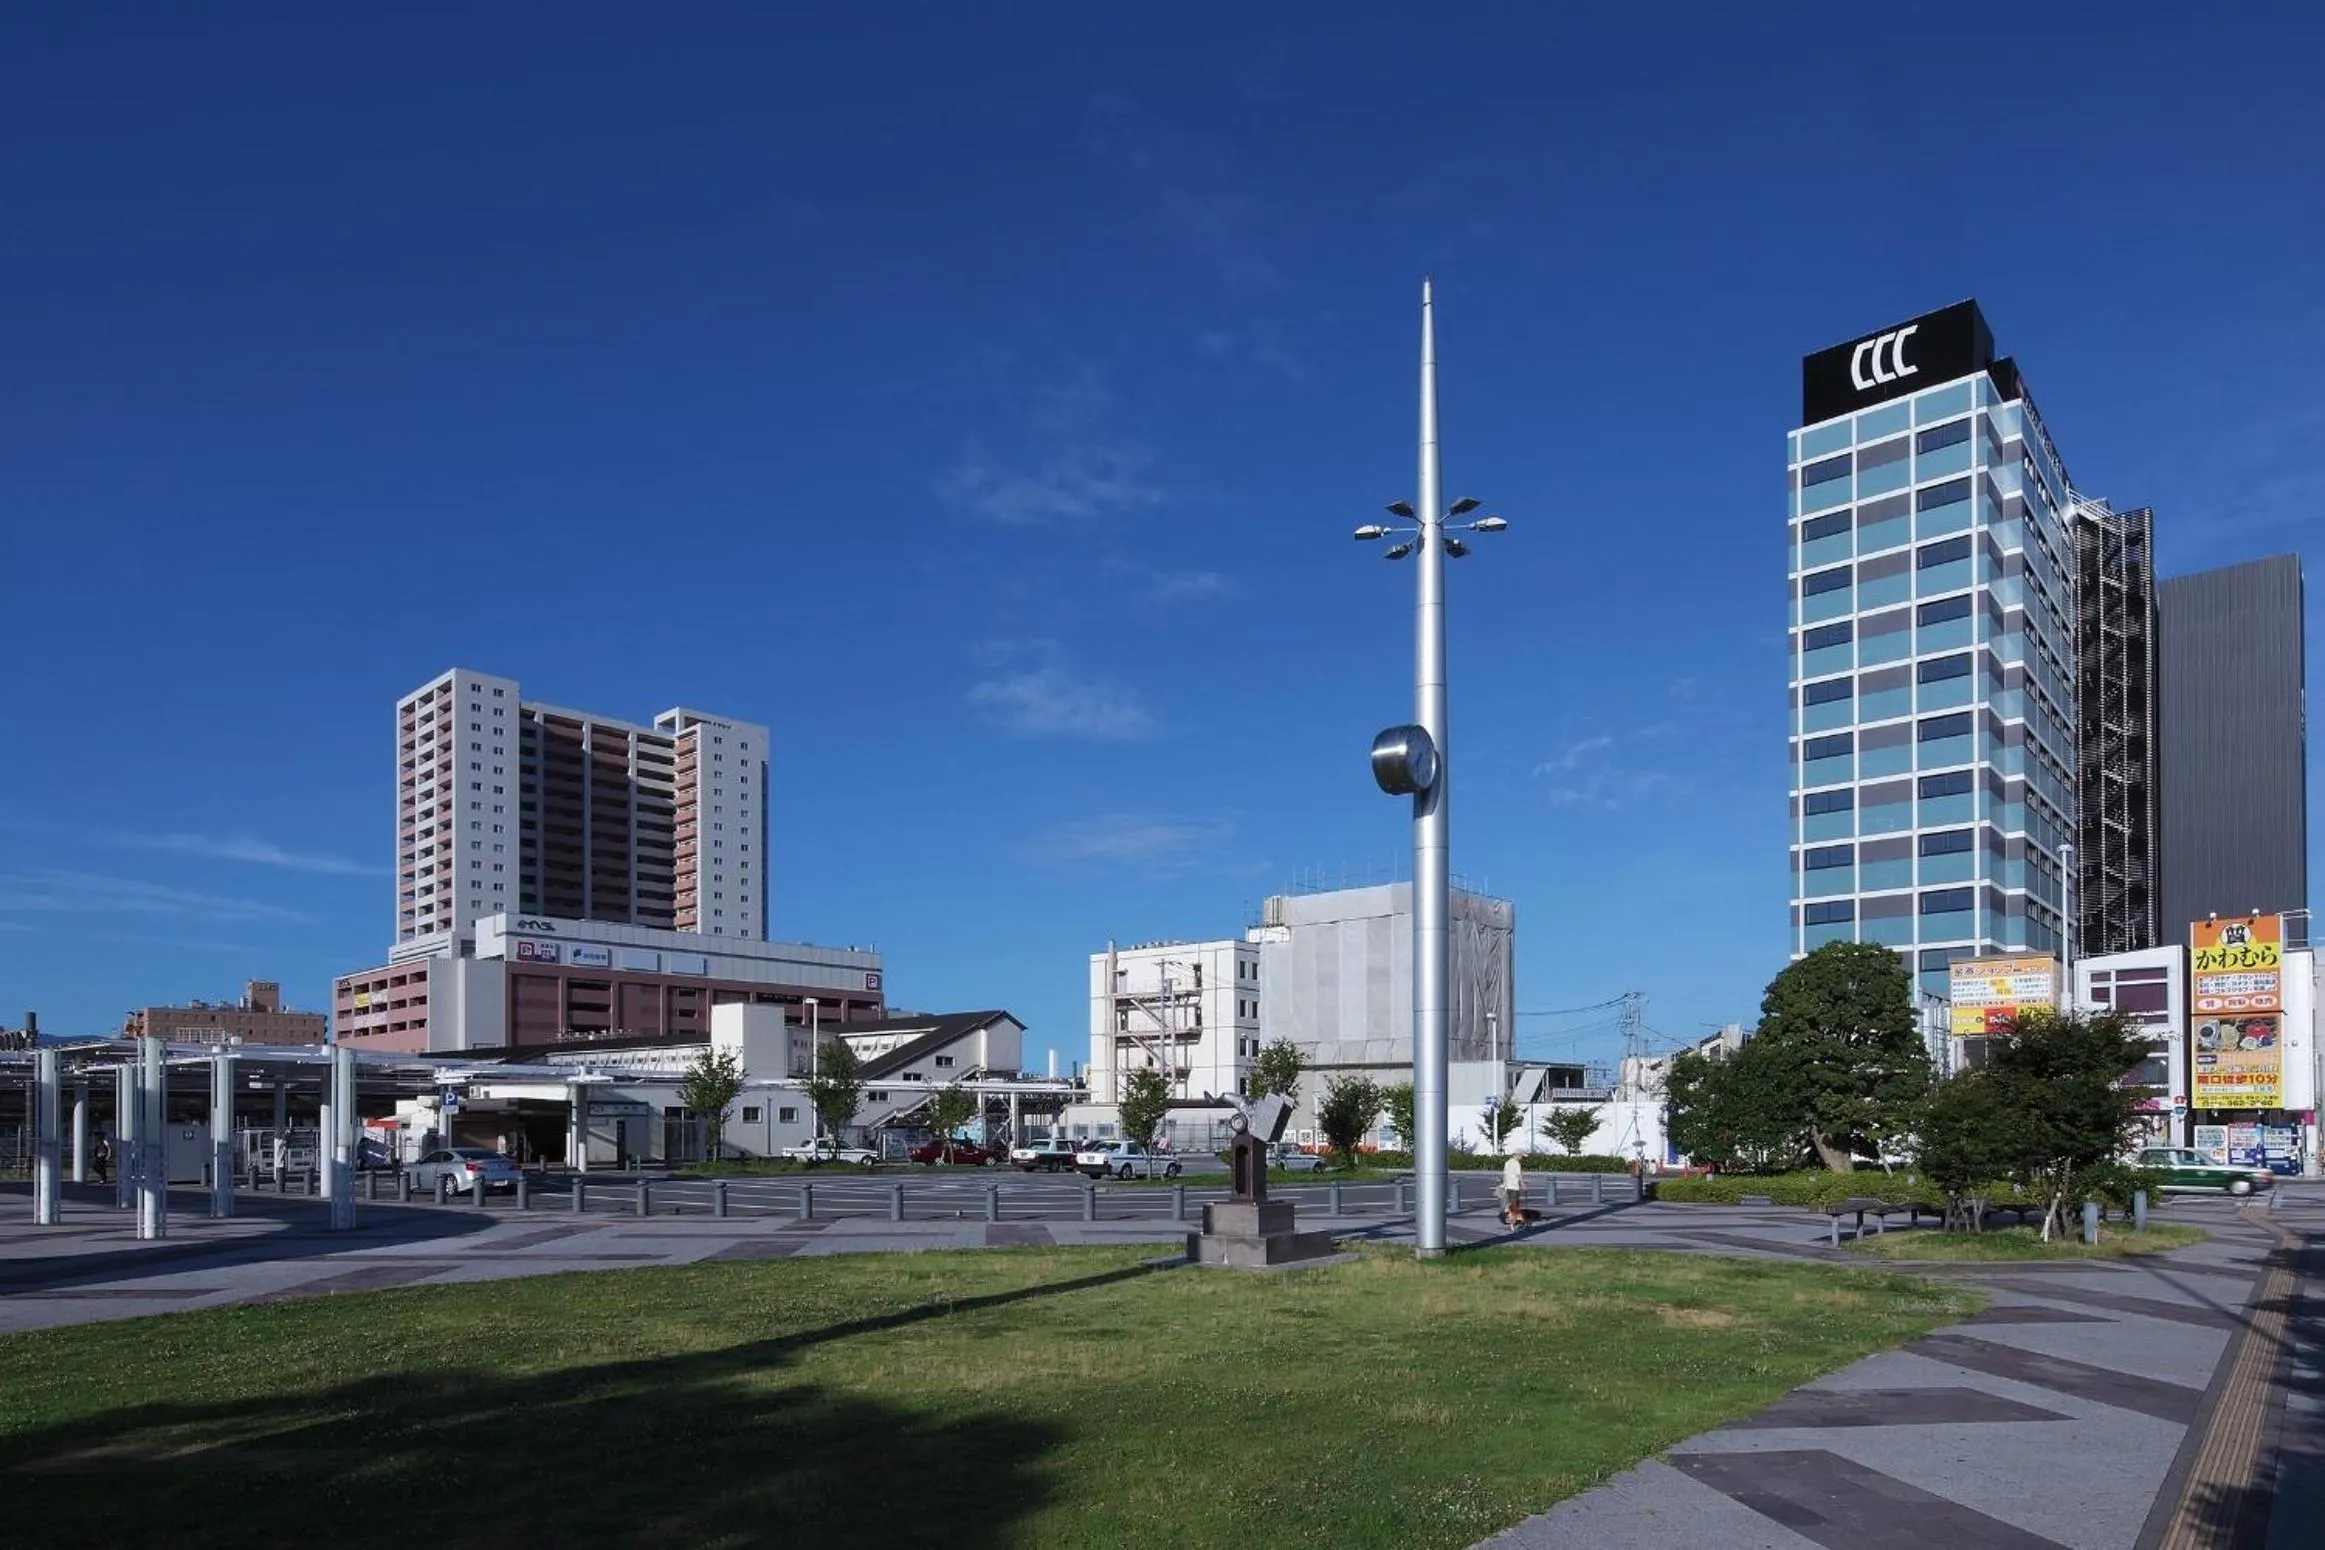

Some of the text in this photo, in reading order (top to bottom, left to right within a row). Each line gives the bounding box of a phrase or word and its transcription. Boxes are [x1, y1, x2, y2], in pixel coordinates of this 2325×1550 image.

[1851, 324, 1919, 391] CCC
[2196, 945, 2278, 970] かわむら
[445, 1092, 456, 1105] P
